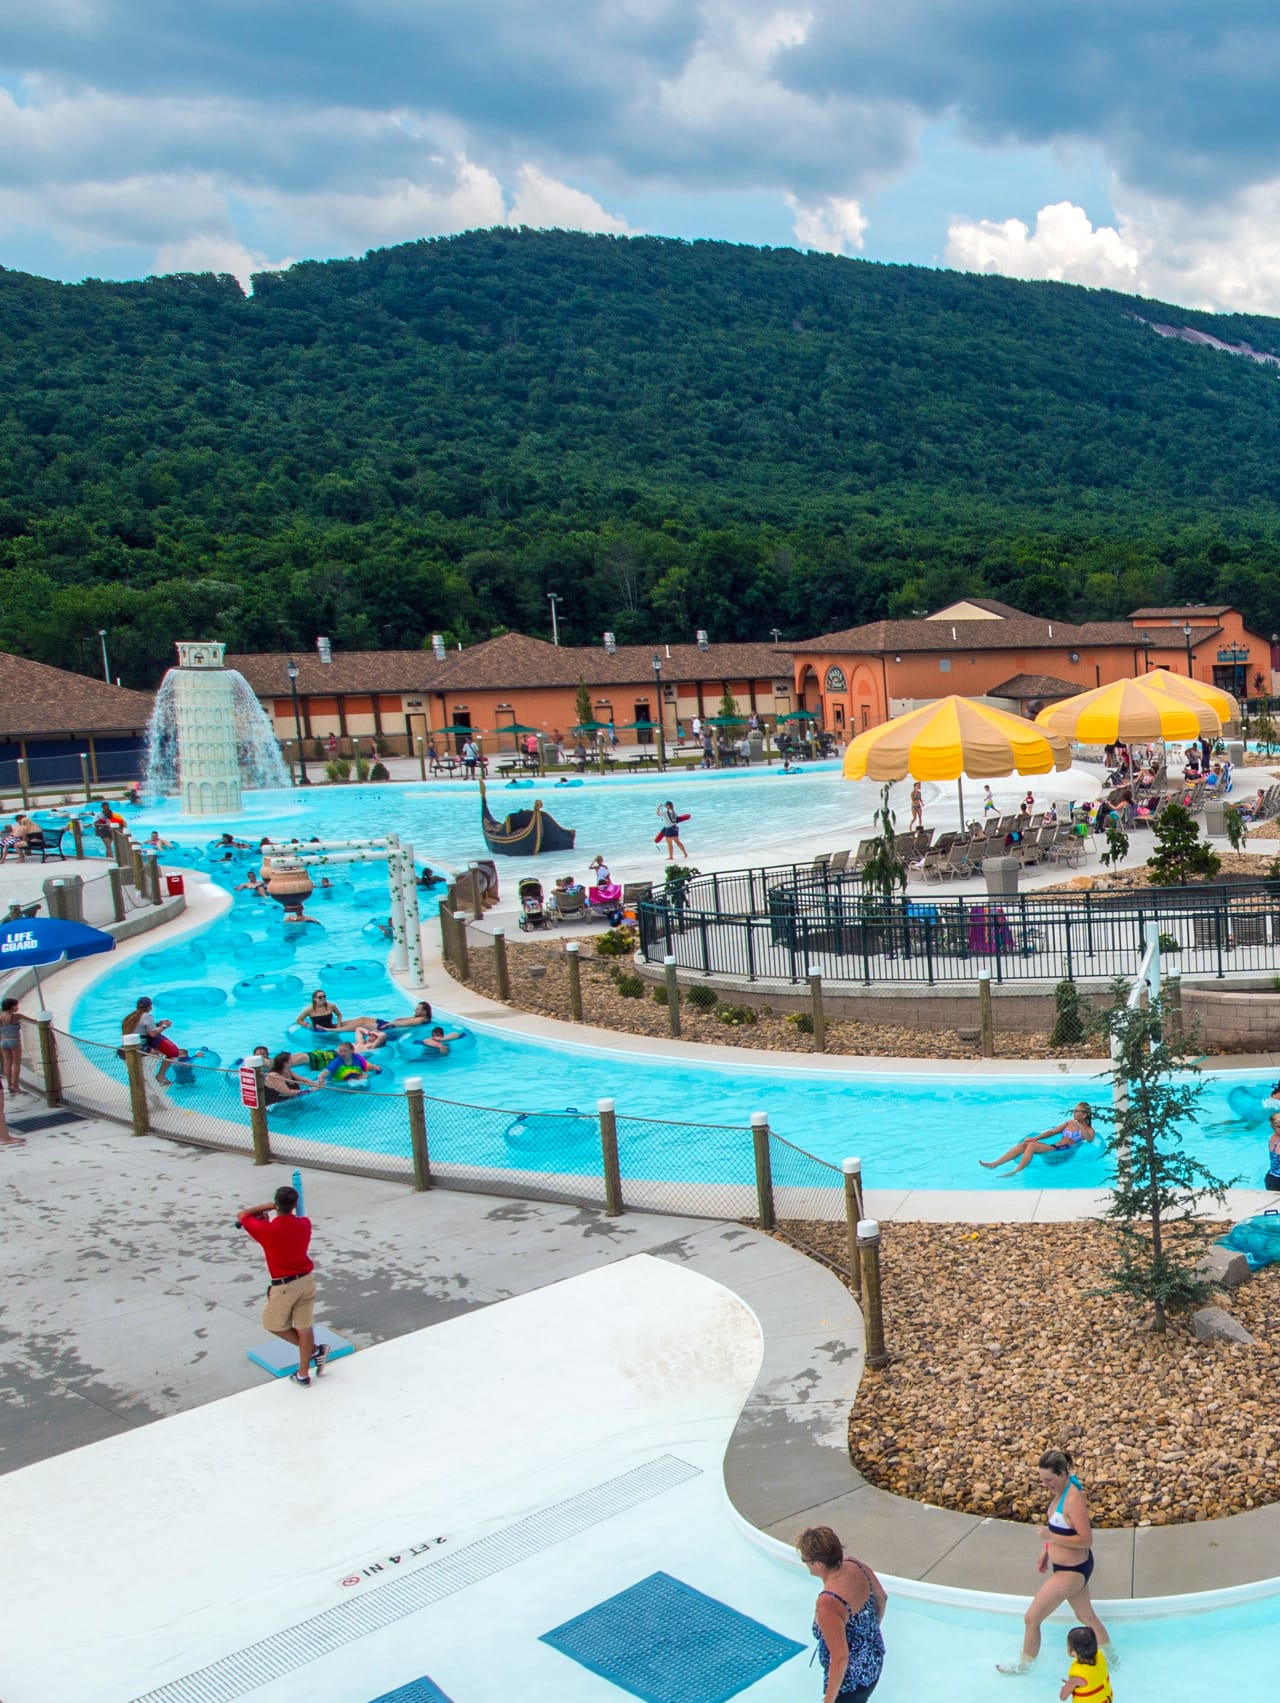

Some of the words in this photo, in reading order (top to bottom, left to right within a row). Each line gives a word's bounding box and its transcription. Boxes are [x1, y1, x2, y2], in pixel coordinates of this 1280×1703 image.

[7, 931, 34, 943] LIFE
[1, 940, 38, 952] GUARD
[409, 1543, 430, 1556] FT
[389, 1555, 401, 1564] 4
[362, 1563, 384, 1576] IN
